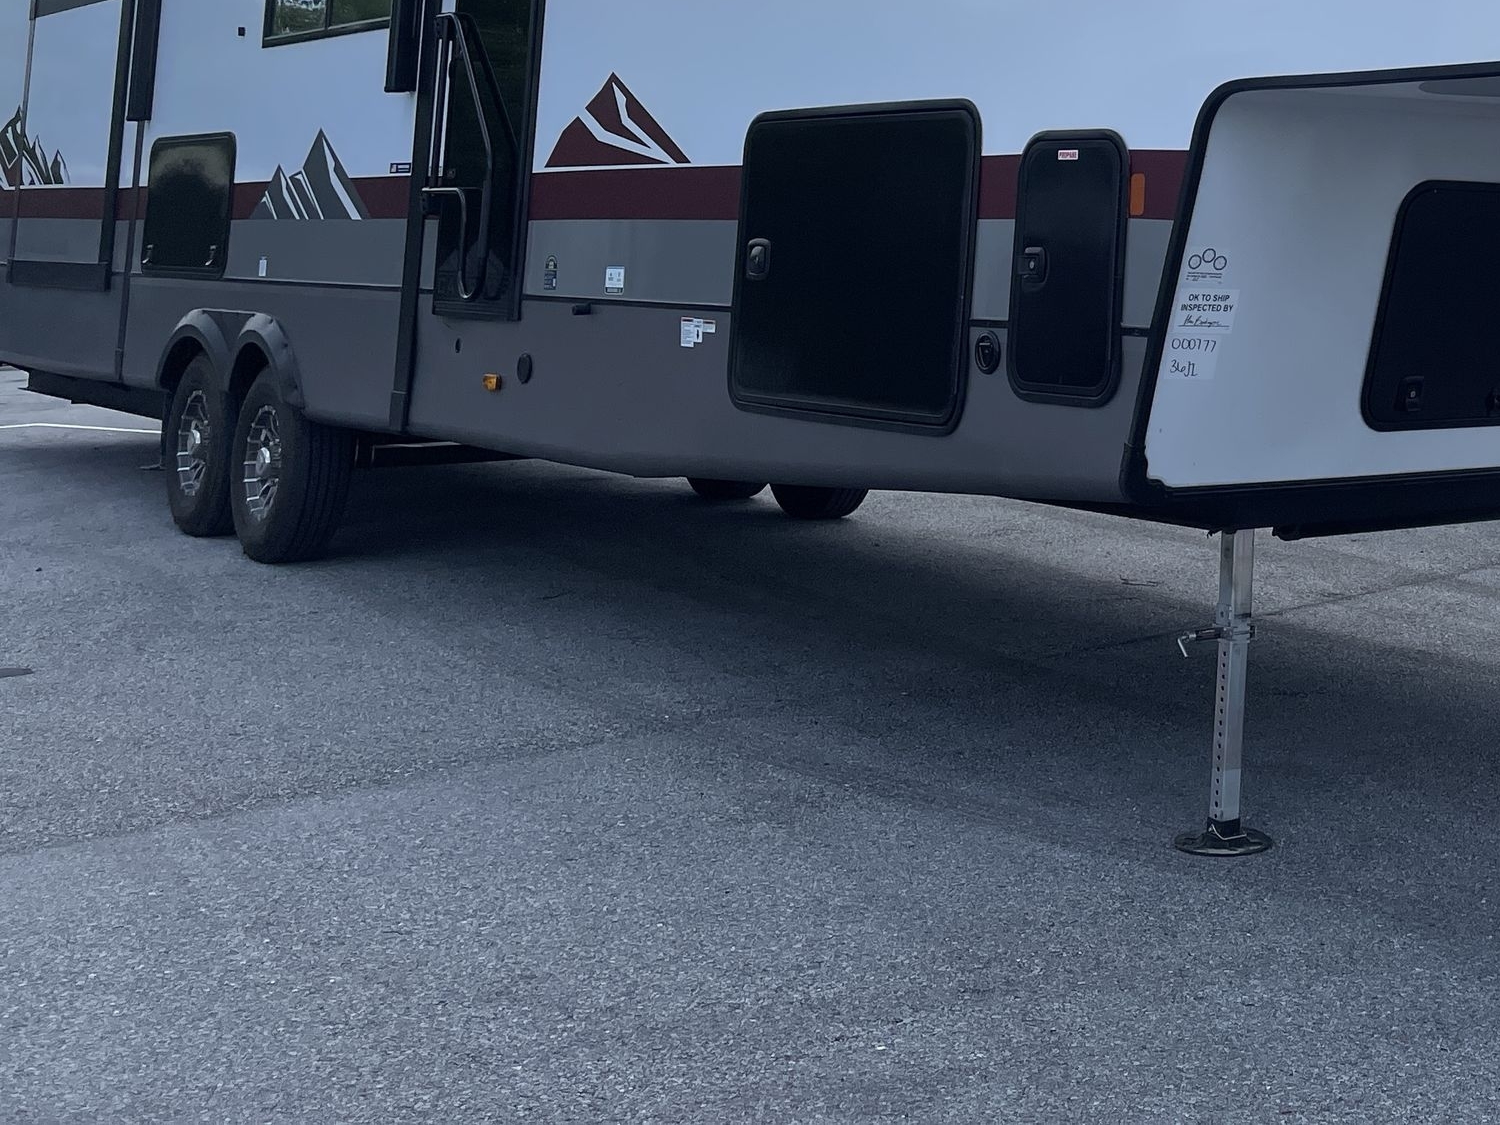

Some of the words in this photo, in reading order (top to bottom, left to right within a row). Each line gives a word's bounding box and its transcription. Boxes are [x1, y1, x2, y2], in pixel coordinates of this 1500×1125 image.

[1188, 294, 1200, 302] OK
[1202, 294, 1211, 302] TO
[1213, 294, 1230, 302] SHIP
[1181, 303, 1222, 312] INSPECTED
[1223, 304, 1234, 312] BY
[1171, 338, 1217, 353] 000777
